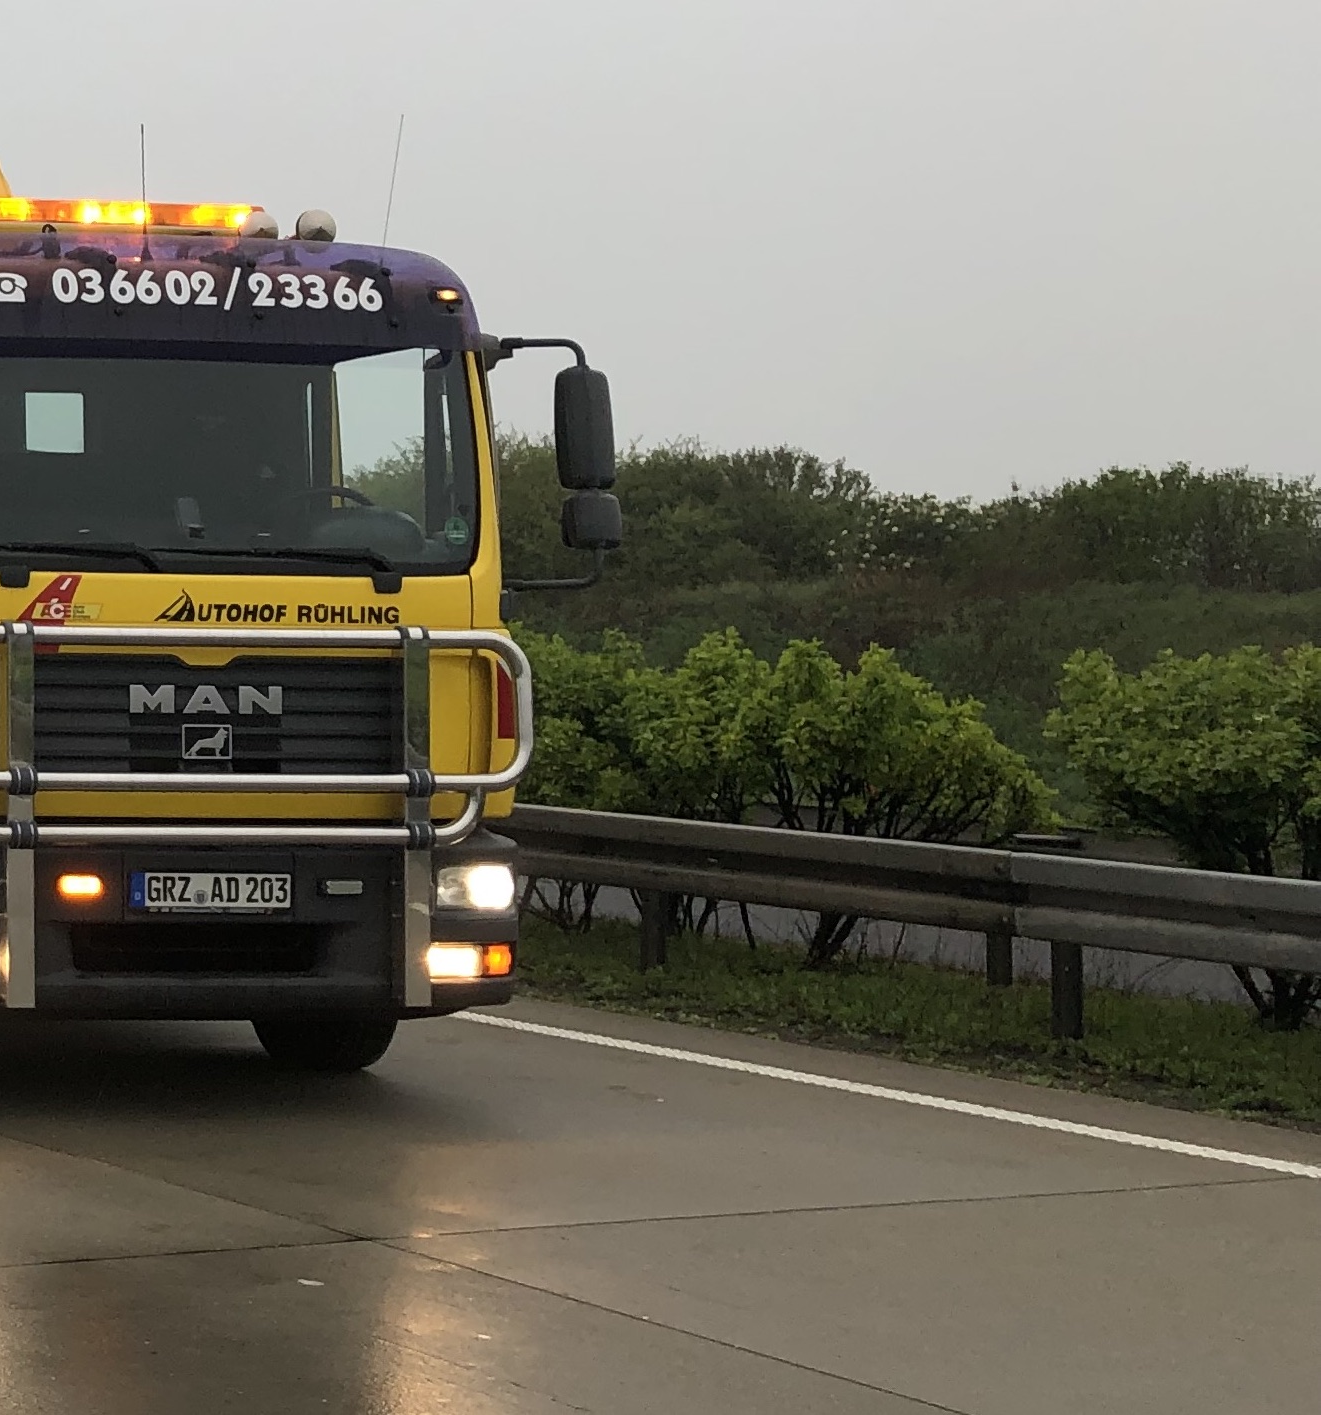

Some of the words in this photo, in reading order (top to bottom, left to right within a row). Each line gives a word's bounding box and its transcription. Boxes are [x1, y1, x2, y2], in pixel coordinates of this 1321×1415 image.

[51, 266, 383, 313] 036602/23366
[297, 602, 400, 625] RÜHLING
[129, 684, 283, 715] MAN
[147, 876, 192, 903] GRZ
[211, 876, 240, 903] AD
[246, 877, 289, 904] 203
